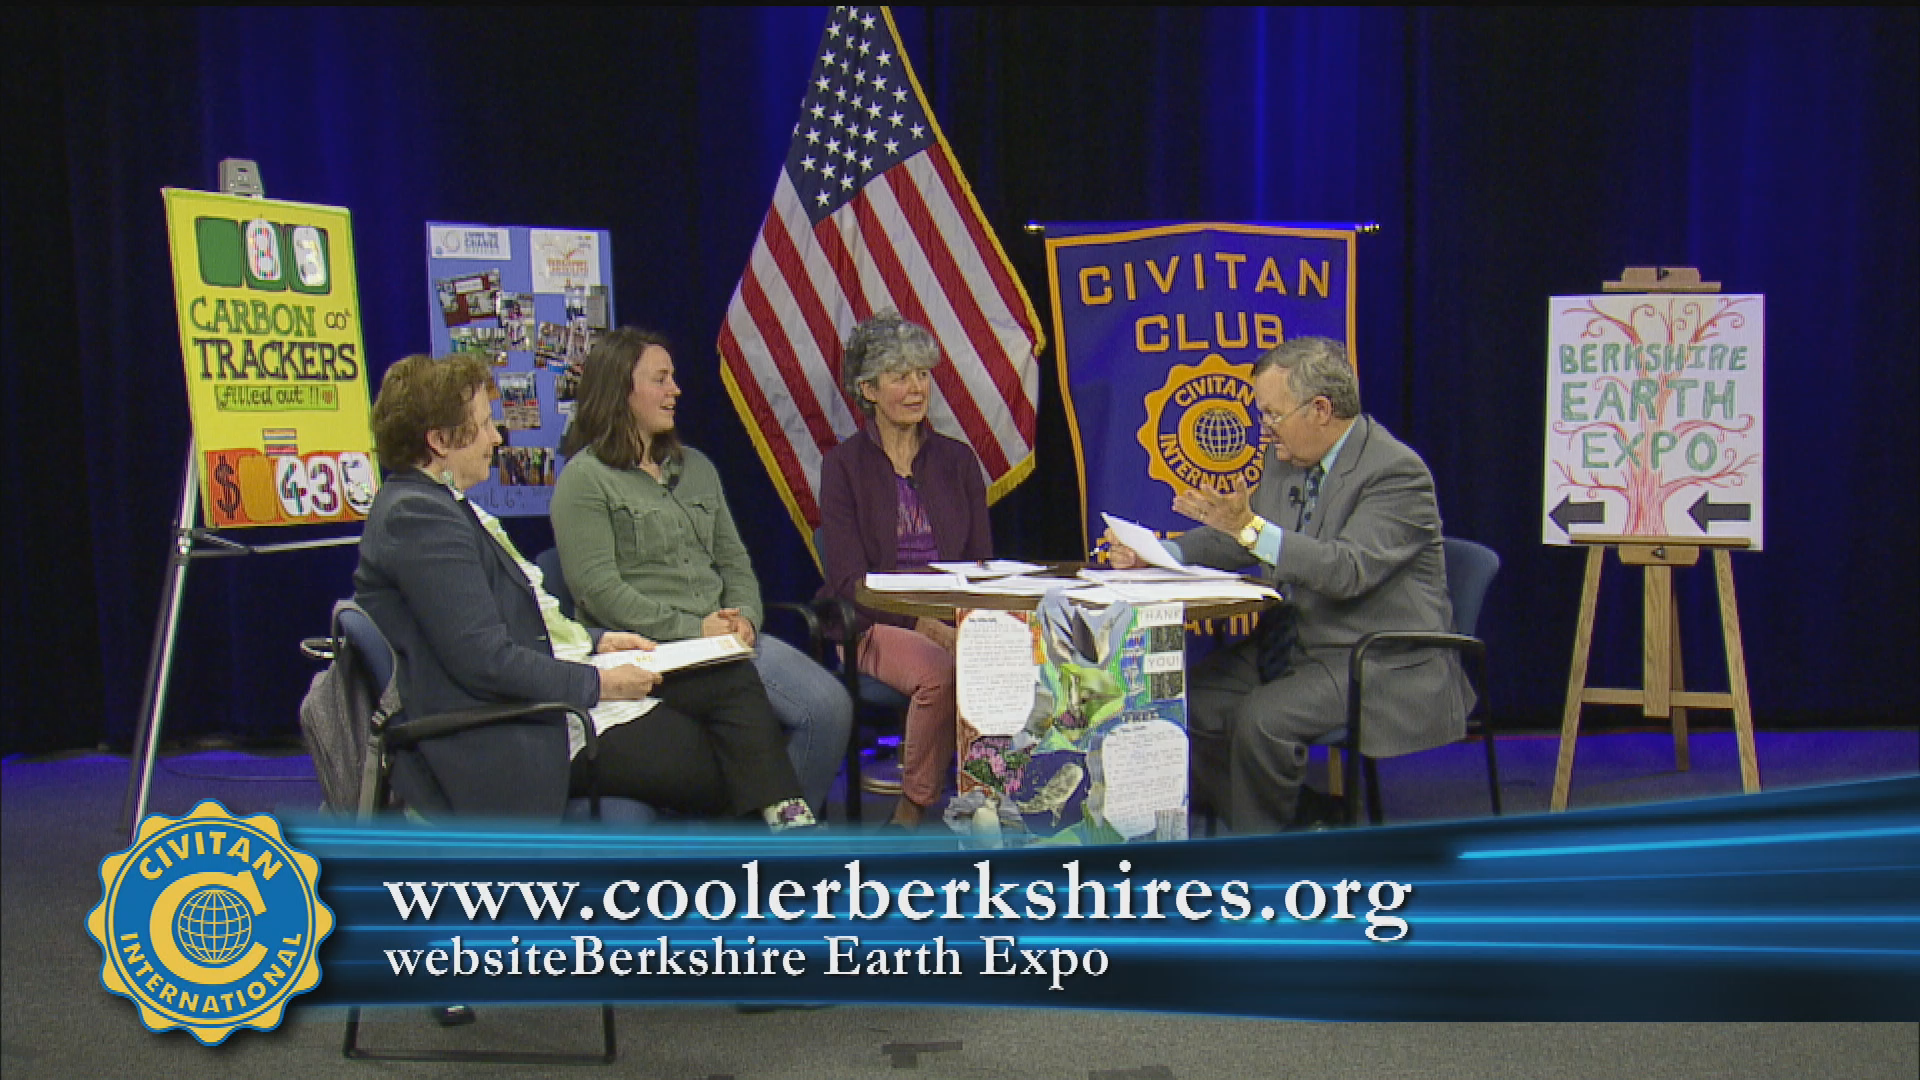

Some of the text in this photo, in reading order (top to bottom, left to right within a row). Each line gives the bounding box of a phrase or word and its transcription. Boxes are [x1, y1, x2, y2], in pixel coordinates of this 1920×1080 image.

[1078, 251, 1331, 306] CIVITAN
[190, 296, 316, 337] CARBON
[1135, 310, 1285, 353] CLUB
[193, 337, 359, 382] TRACKERS
[1558, 343, 1749, 375] BERKSHIRE
[219, 385, 273, 409] filled
[275, 385, 305, 405] out
[1174, 376, 1256, 408] CIVITAN
[1560, 378, 1738, 423] EARTH
[1581, 431, 1719, 472] EXPO
